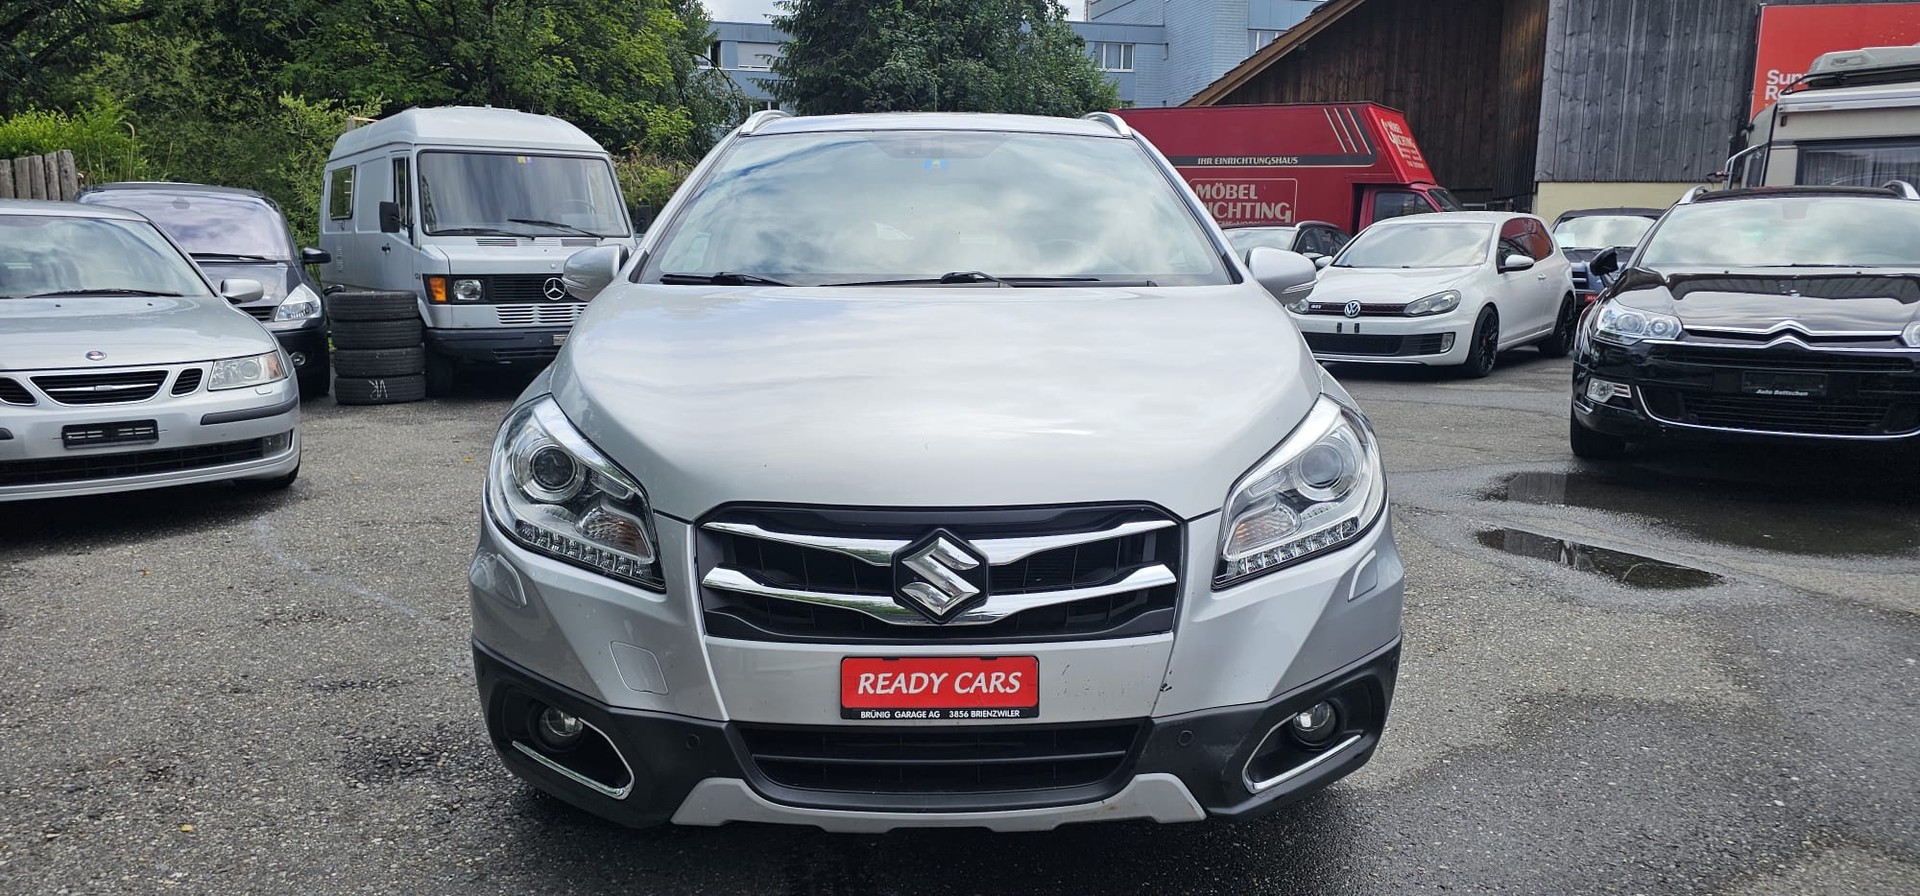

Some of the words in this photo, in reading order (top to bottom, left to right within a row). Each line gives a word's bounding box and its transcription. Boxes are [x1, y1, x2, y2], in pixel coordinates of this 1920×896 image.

[1198, 157, 1213, 165] IHR
[1214, 156, 1298, 165] EINRICHTUNGSHAUS
[1195, 182, 1258, 199] MÖBEL
[1204, 202, 1292, 223] ICHTING
[858, 672, 949, 695] READY
[954, 672, 1022, 694] CARS
[860, 709, 890, 719] BRÜNIG
[894, 711, 927, 719] GARAGE
[928, 710, 941, 718] AG
[948, 710, 969, 718] 3856
[970, 709, 1020, 718] BRIENZWILER
